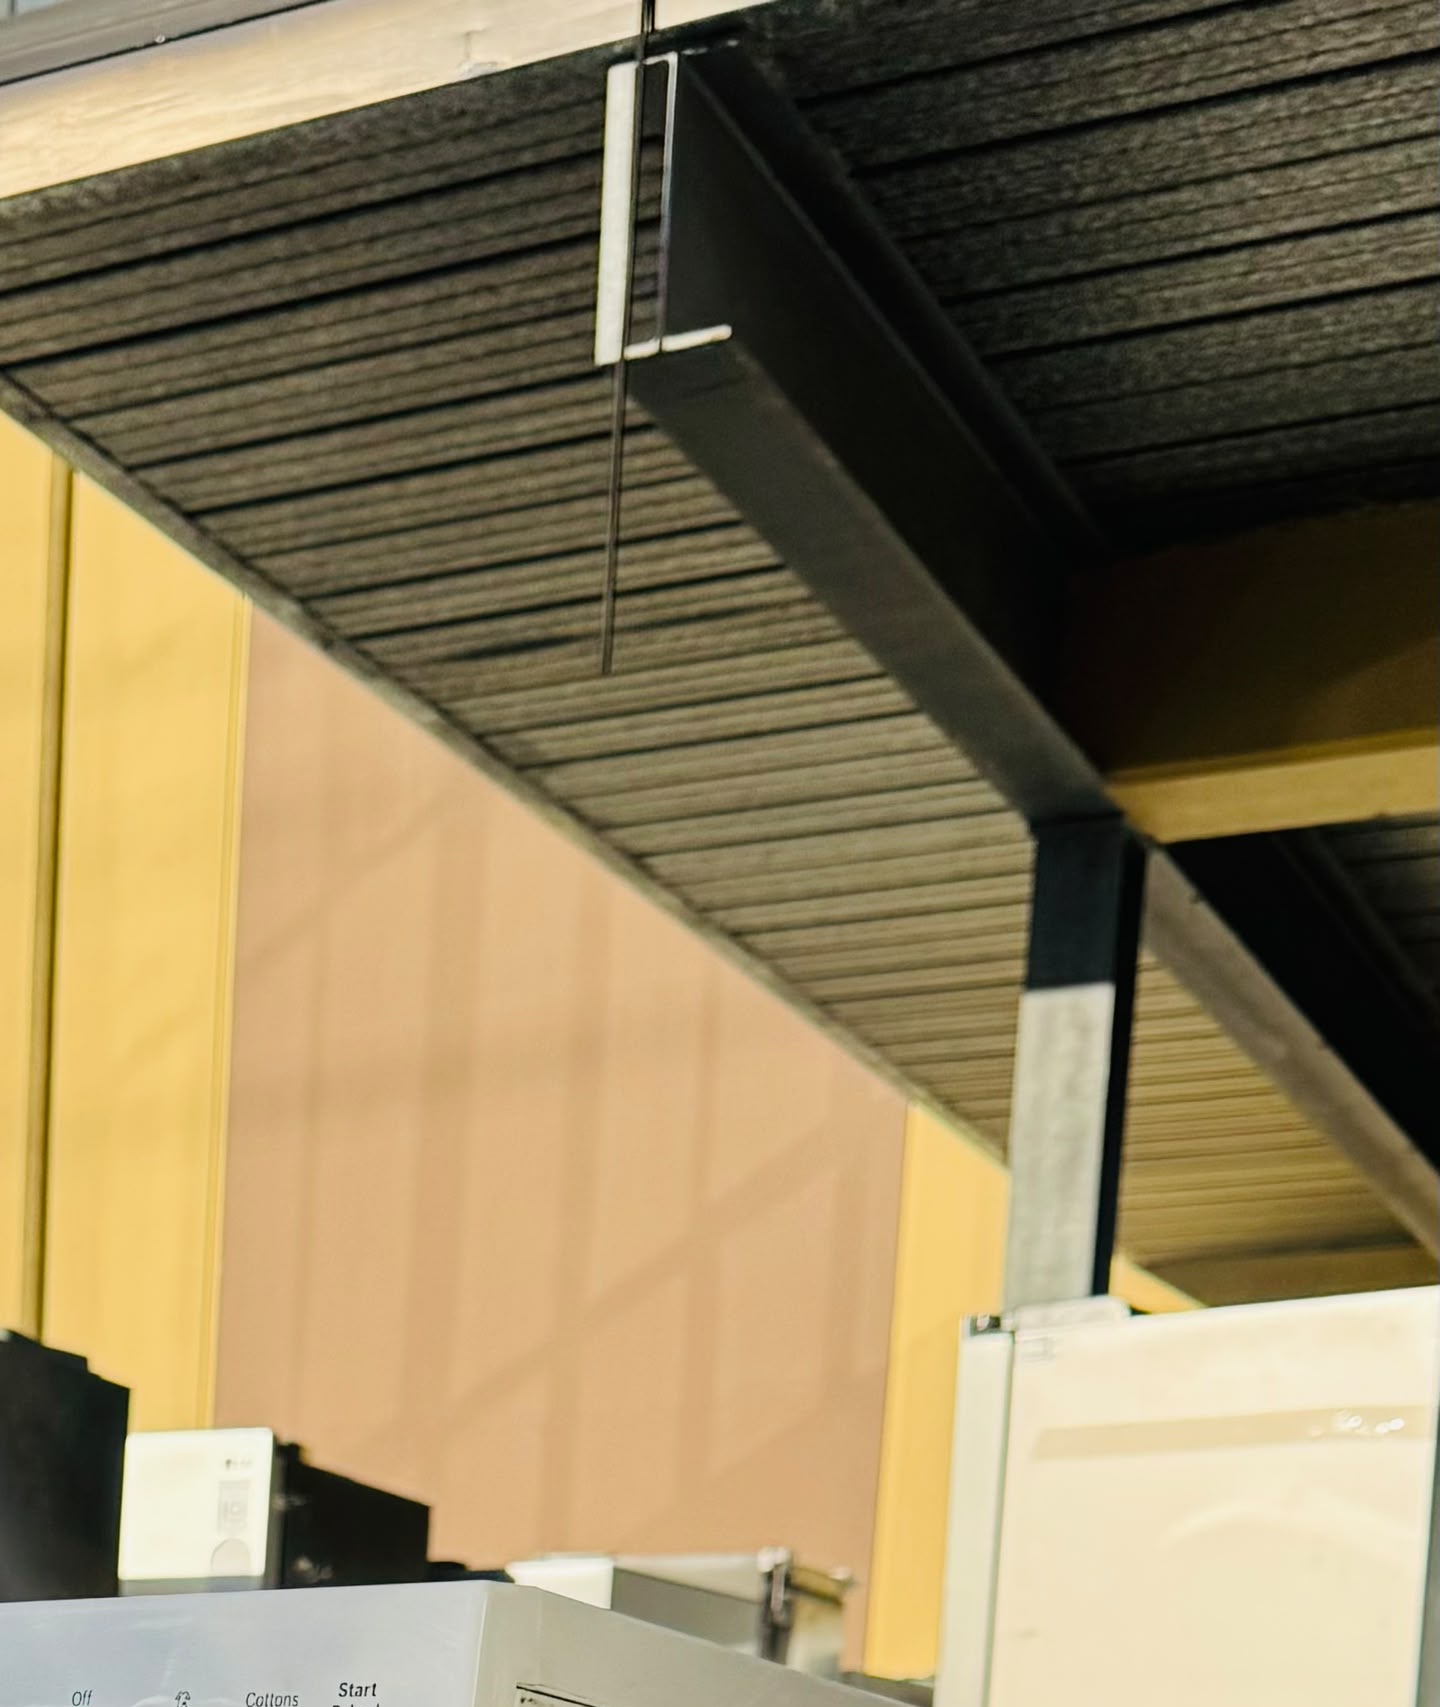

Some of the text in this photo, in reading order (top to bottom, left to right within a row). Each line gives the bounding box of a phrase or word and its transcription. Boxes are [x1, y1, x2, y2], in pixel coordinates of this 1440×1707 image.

[71, 1689, 93, 1707] Off
[338, 1682, 377, 1698] Start
[245, 1691, 299, 1707] Cottons
